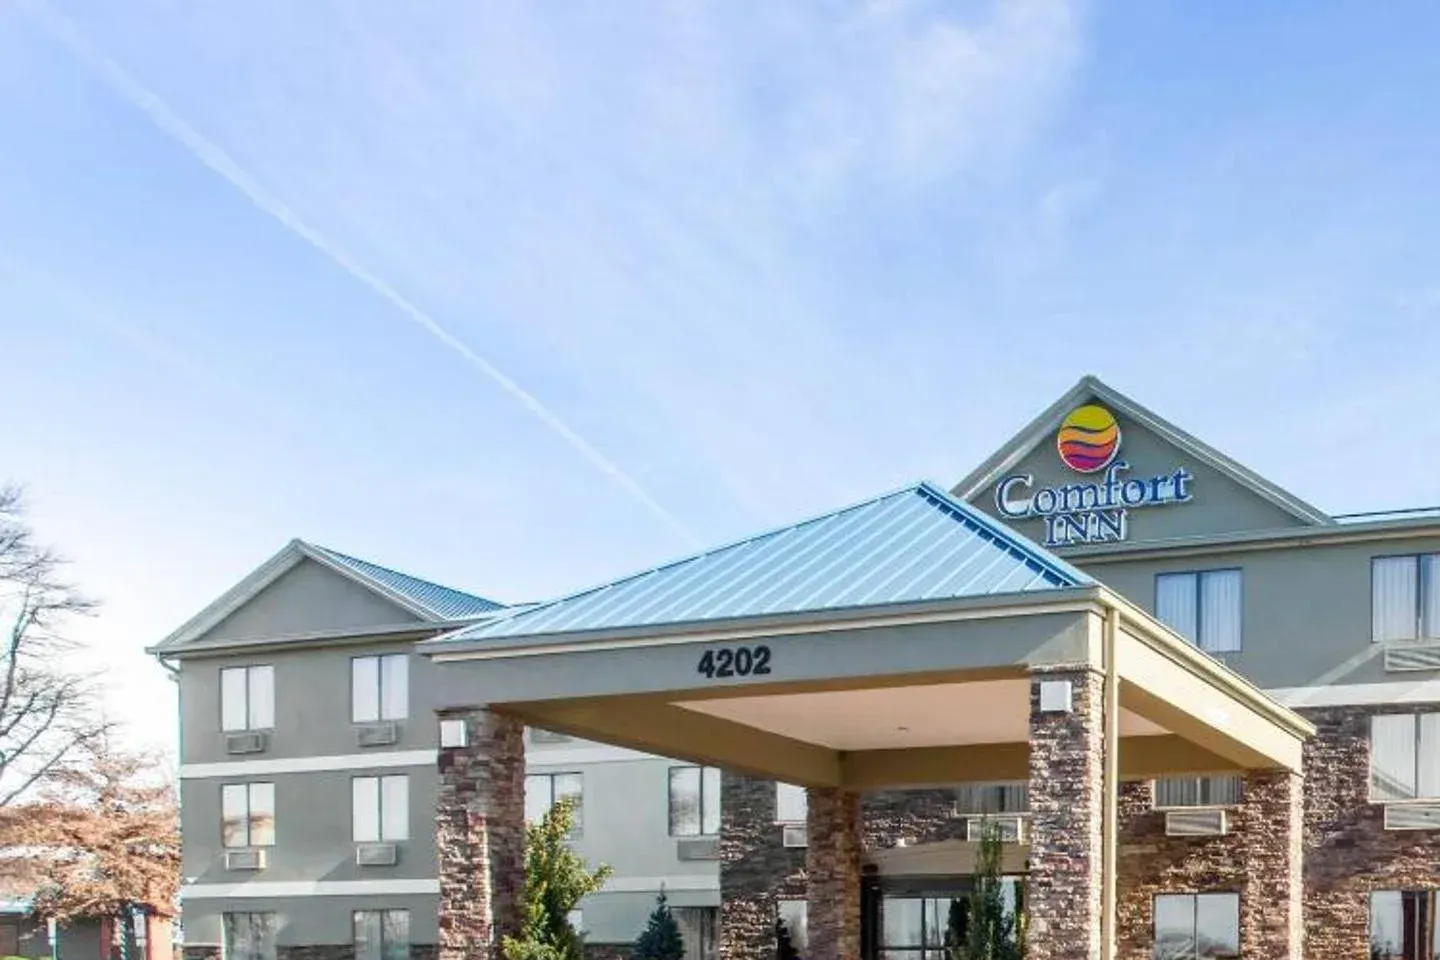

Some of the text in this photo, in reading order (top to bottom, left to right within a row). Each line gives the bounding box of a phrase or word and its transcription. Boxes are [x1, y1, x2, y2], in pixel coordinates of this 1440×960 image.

[996, 460, 1193, 518] Comfort
[1044, 509, 1127, 546] INN
[697, 645, 771, 678] 4202
